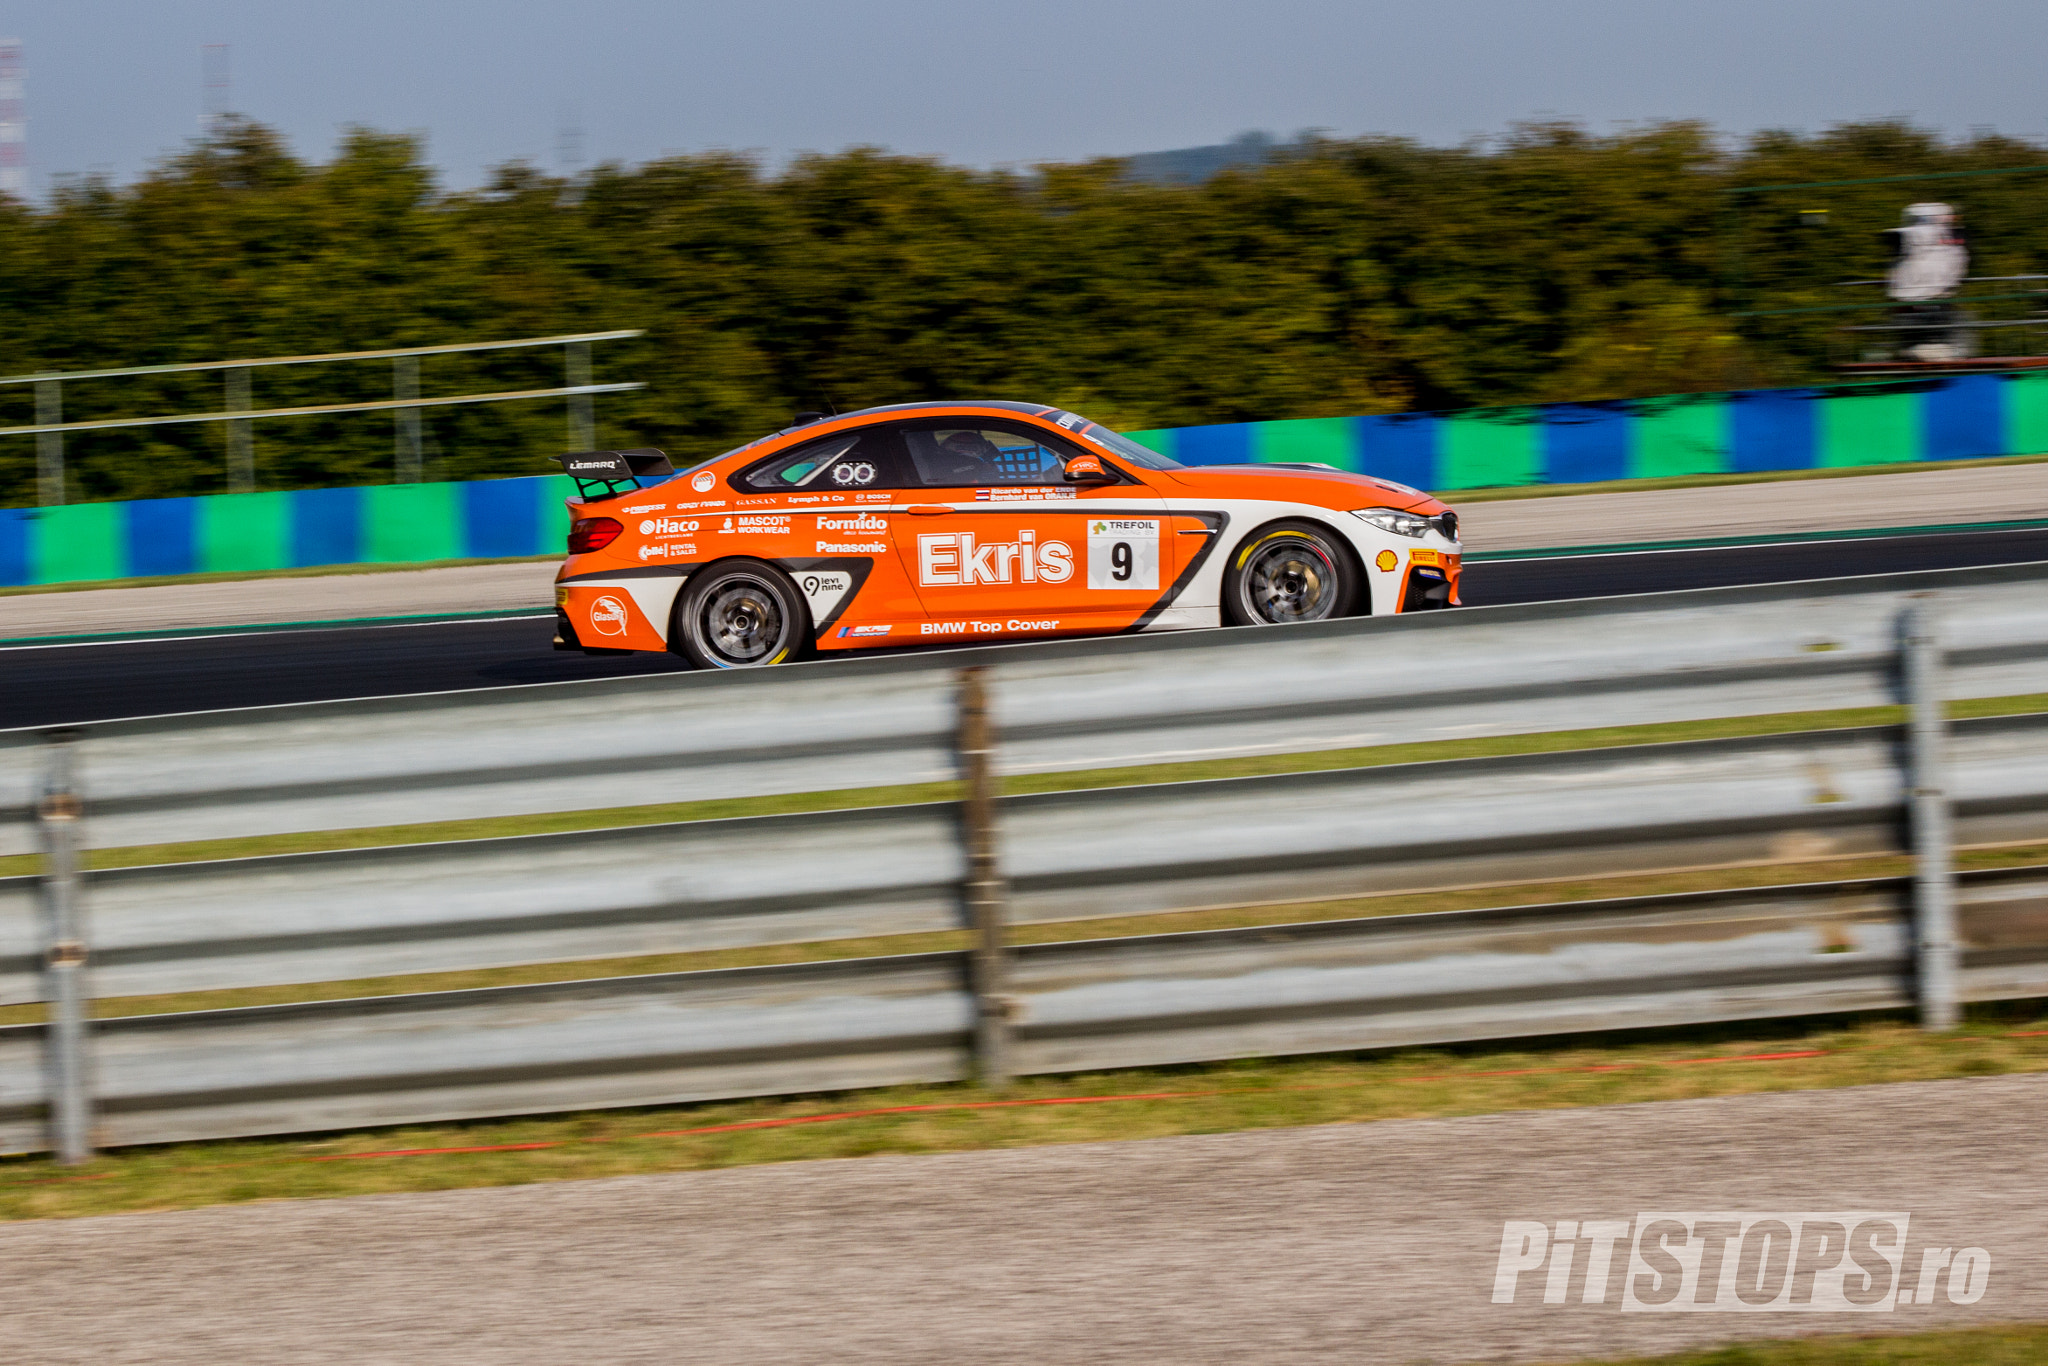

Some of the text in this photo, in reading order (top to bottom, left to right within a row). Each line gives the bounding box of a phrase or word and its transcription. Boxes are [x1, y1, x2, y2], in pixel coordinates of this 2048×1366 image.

[736, 498, 777, 506] GASSAN
[788, 496, 819, 504] Lymph
[655, 519, 700, 534] Haco
[816, 513, 887, 530] Formido
[1109, 521, 1155, 530] TREFOIL
[816, 541, 887, 553] Panasonic
[917, 530, 1075, 588] Ekris
[1111, 542, 1134, 582] 9
[920, 619, 1060, 635] BMW Top Cover
